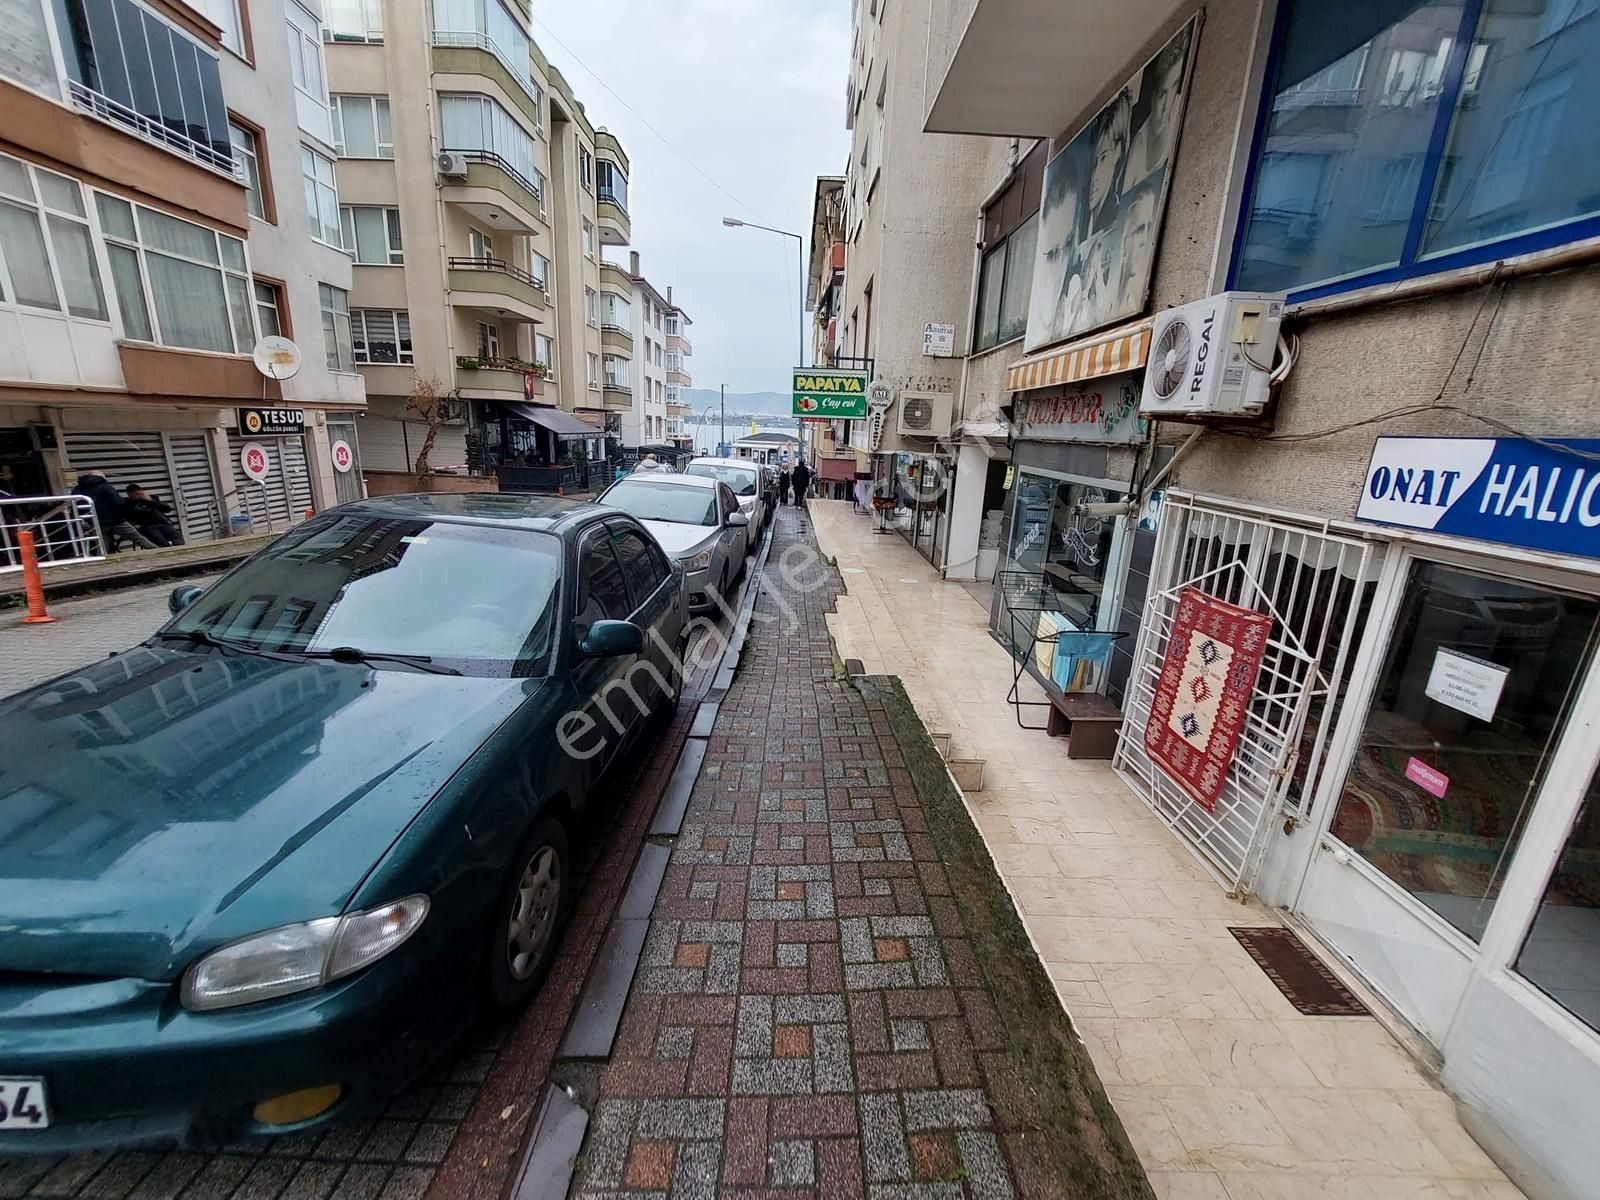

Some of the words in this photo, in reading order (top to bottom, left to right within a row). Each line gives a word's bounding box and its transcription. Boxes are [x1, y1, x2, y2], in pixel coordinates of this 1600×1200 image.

[1191, 310, 1216, 393] REGAL
[796, 376, 861, 392] PAPATYA
[821, 397, 841, 409] Çay
[841, 399, 857, 408] evi
[262, 410, 304, 424] TESUD
[1370, 466, 1461, 507] ONAT
